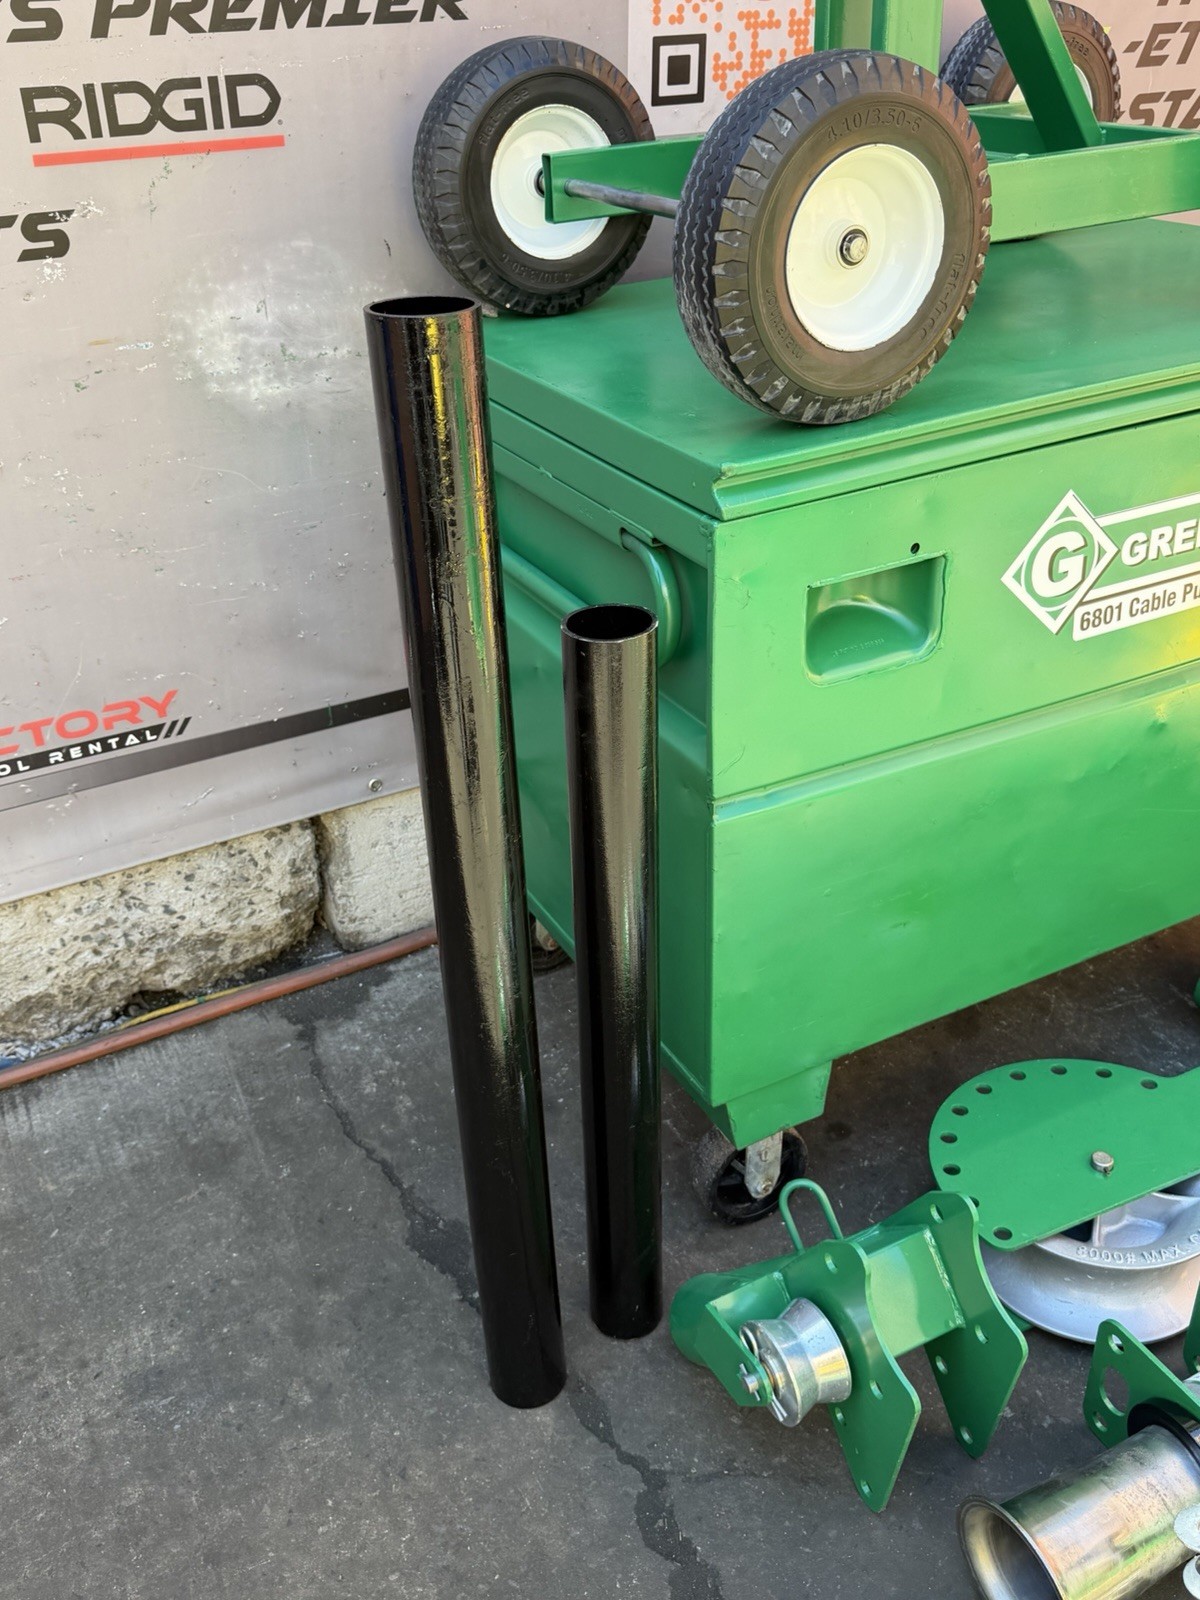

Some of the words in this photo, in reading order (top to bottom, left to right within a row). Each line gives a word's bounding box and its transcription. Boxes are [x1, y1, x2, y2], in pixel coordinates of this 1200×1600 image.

[19, 72, 283, 144] RIDGID
[0, 208, 76, 263] S
[1120, 517, 1200, 567] GRE
[1079, 601, 1123, 633] 6801
[1128, 588, 1177, 618] Cable
[48, 728, 158, 765] RENTAL
